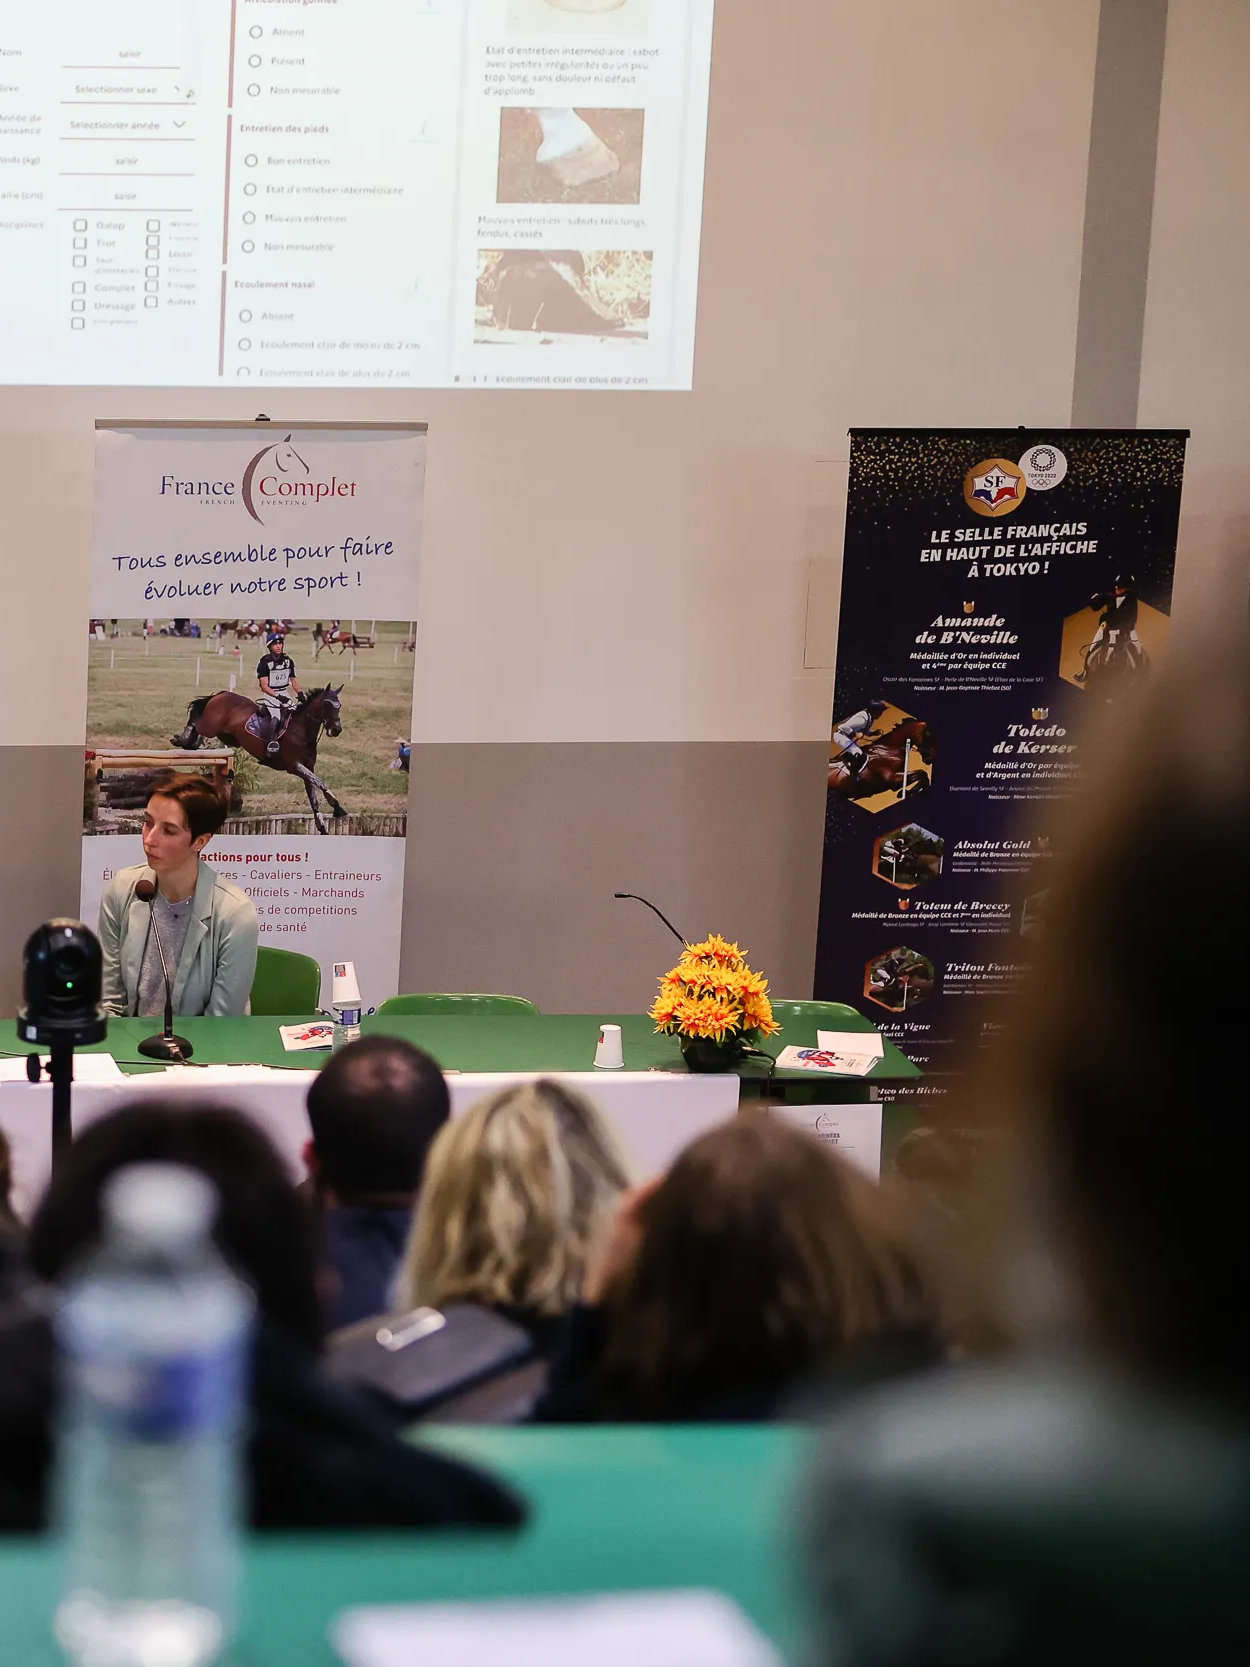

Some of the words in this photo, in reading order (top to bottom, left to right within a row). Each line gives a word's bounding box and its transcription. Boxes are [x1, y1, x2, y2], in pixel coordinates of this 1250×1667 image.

[984, 476, 1006, 488] SF
[159, 475, 235, 496] France
[259, 476, 357, 502] Complet
[931, 529, 950, 544] LE
[954, 527, 1002, 542] SELLE
[1007, 522, 1088, 541] FRANÇAIS
[112, 555, 167, 571] Tous
[174, 544, 277, 567] ensemble
[283, 544, 335, 567] pour
[340, 536, 394, 564] faire
[920, 549, 942, 562] EN
[946, 547, 989, 561] HAUT
[994, 545, 1015, 558] DE
[1019, 540, 1098, 557] L'AFFICHE
[968, 562, 979, 578] À
[984, 563, 1040, 577] TOKYO
[1043, 562, 1049, 574] !
[144, 579, 223, 600] évoluer
[230, 575, 286, 593] notre
[293, 571, 348, 597] sport
[357, 571, 362, 586] !
[931, 614, 1006, 628] Amande
[915, 632, 936, 644] de
[939, 631, 1019, 645] B'Neville
[910, 652, 949, 660] Médaillée
[950, 652, 967, 660] d'Or
[980, 652, 1020, 660] individuel
[963, 662, 990, 670] équipe
[1007, 724, 1066, 737] Toledo
[992, 742, 1013, 754] de
[986, 771, 1019, 780] d'Argent
[954, 840, 999, 849] Absolut
[1003, 840, 1031, 849] Gold
[201, 852, 243, 863] actions
[246, 854, 272, 865] pour
[275, 853, 301, 863] tous
[304, 853, 309, 862] !
[250, 870, 302, 880] Cavaliers
[314, 870, 382, 882] Entraineurs
[245, 887, 289, 897] Officiels
[302, 887, 365, 898] Marchands
[267, 905, 281, 915] de
[284, 904, 357, 917] competitions
[914, 901, 951, 910] Totem
[954, 901, 968, 910] de
[919, 912, 940, 920] équipe
[259, 922, 273, 932] de
[276, 922, 307, 932] santé
[946, 962, 984, 971] Triton
[904, 1023, 931, 1032] Vigne
